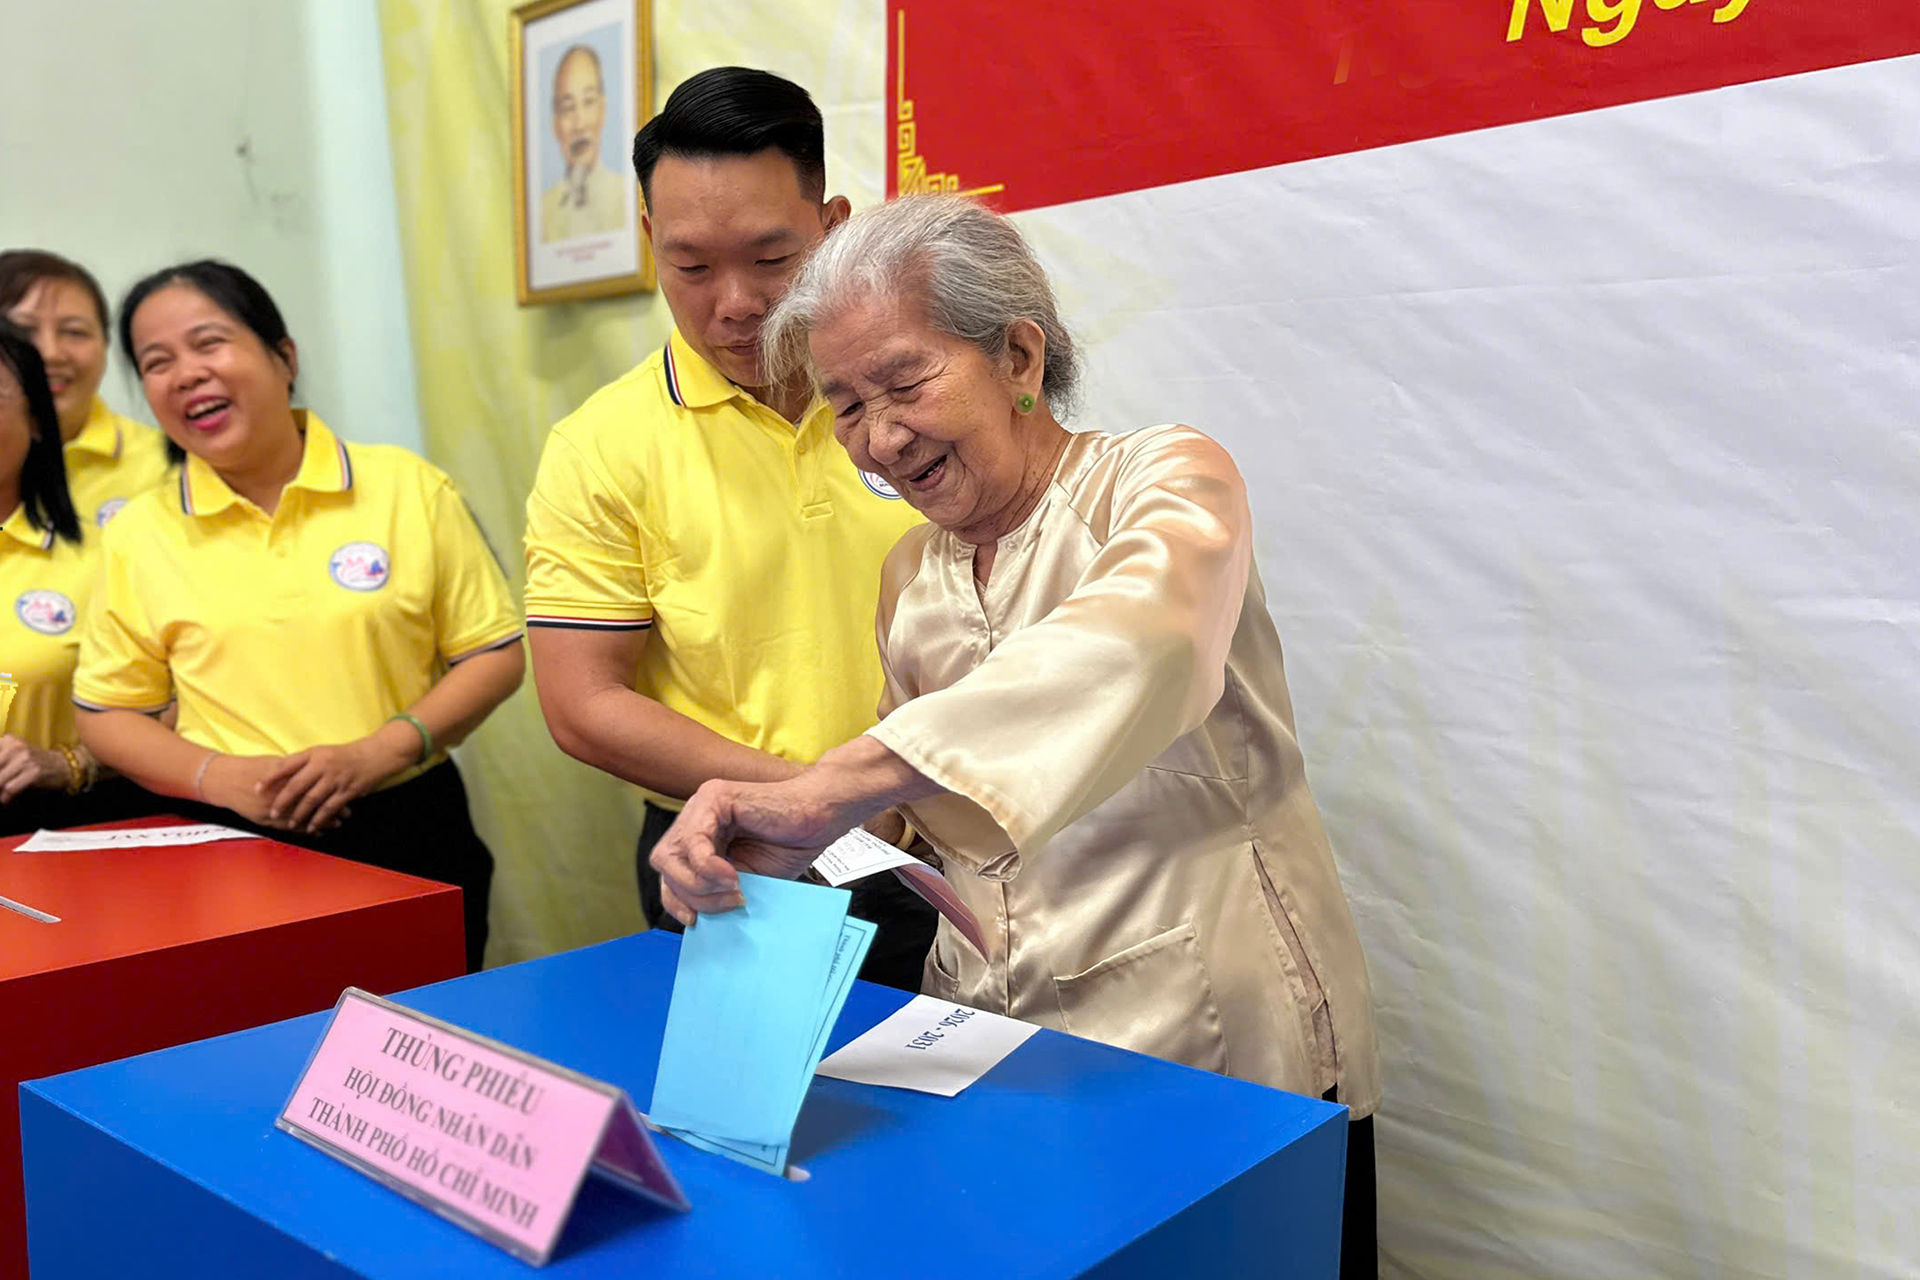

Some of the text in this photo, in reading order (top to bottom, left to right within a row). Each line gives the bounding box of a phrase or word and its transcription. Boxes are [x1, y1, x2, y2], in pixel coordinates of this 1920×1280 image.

[906, 1031, 944, 1050] 2031
[938, 1008, 976, 1028] 2026
[380, 1027, 546, 1115] THÙNG PHIẾU
[343, 1067, 538, 1170] HỘI ĐỒNG NHÂN DÂN
[308, 1097, 539, 1229] THÀNH PHỐ HỒ CHÍ MINH
